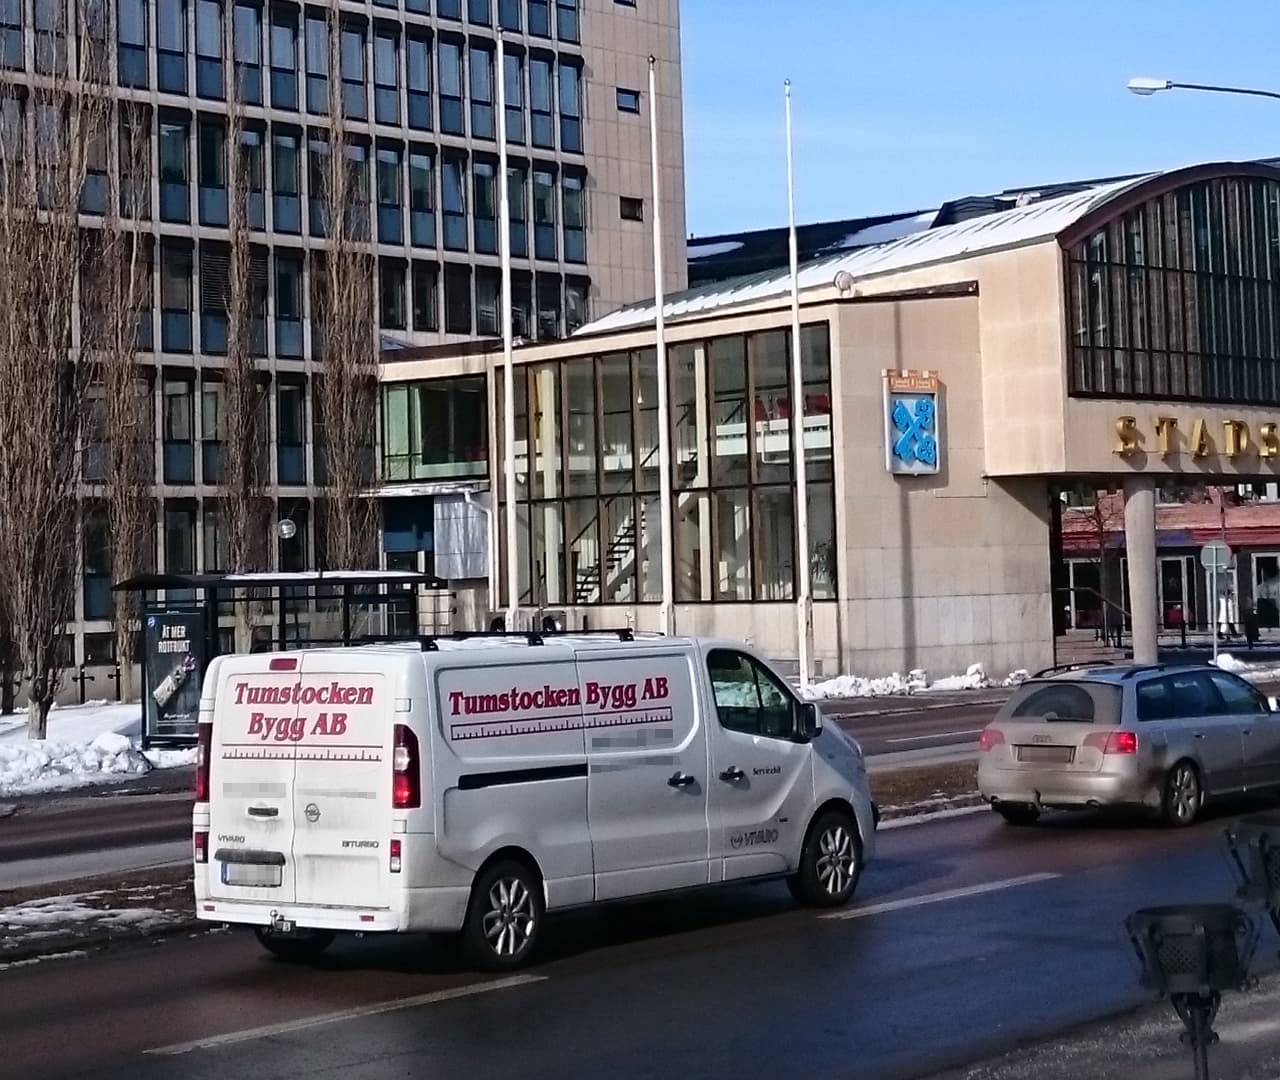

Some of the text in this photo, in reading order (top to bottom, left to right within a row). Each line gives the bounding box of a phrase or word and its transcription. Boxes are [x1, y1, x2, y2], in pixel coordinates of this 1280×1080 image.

[171, 625, 186, 638] MER
[234, 682, 374, 705] Tumstocken
[449, 677, 669, 716] Tumstocken Bygg AB
[248, 712, 348, 742] Bygg AB
